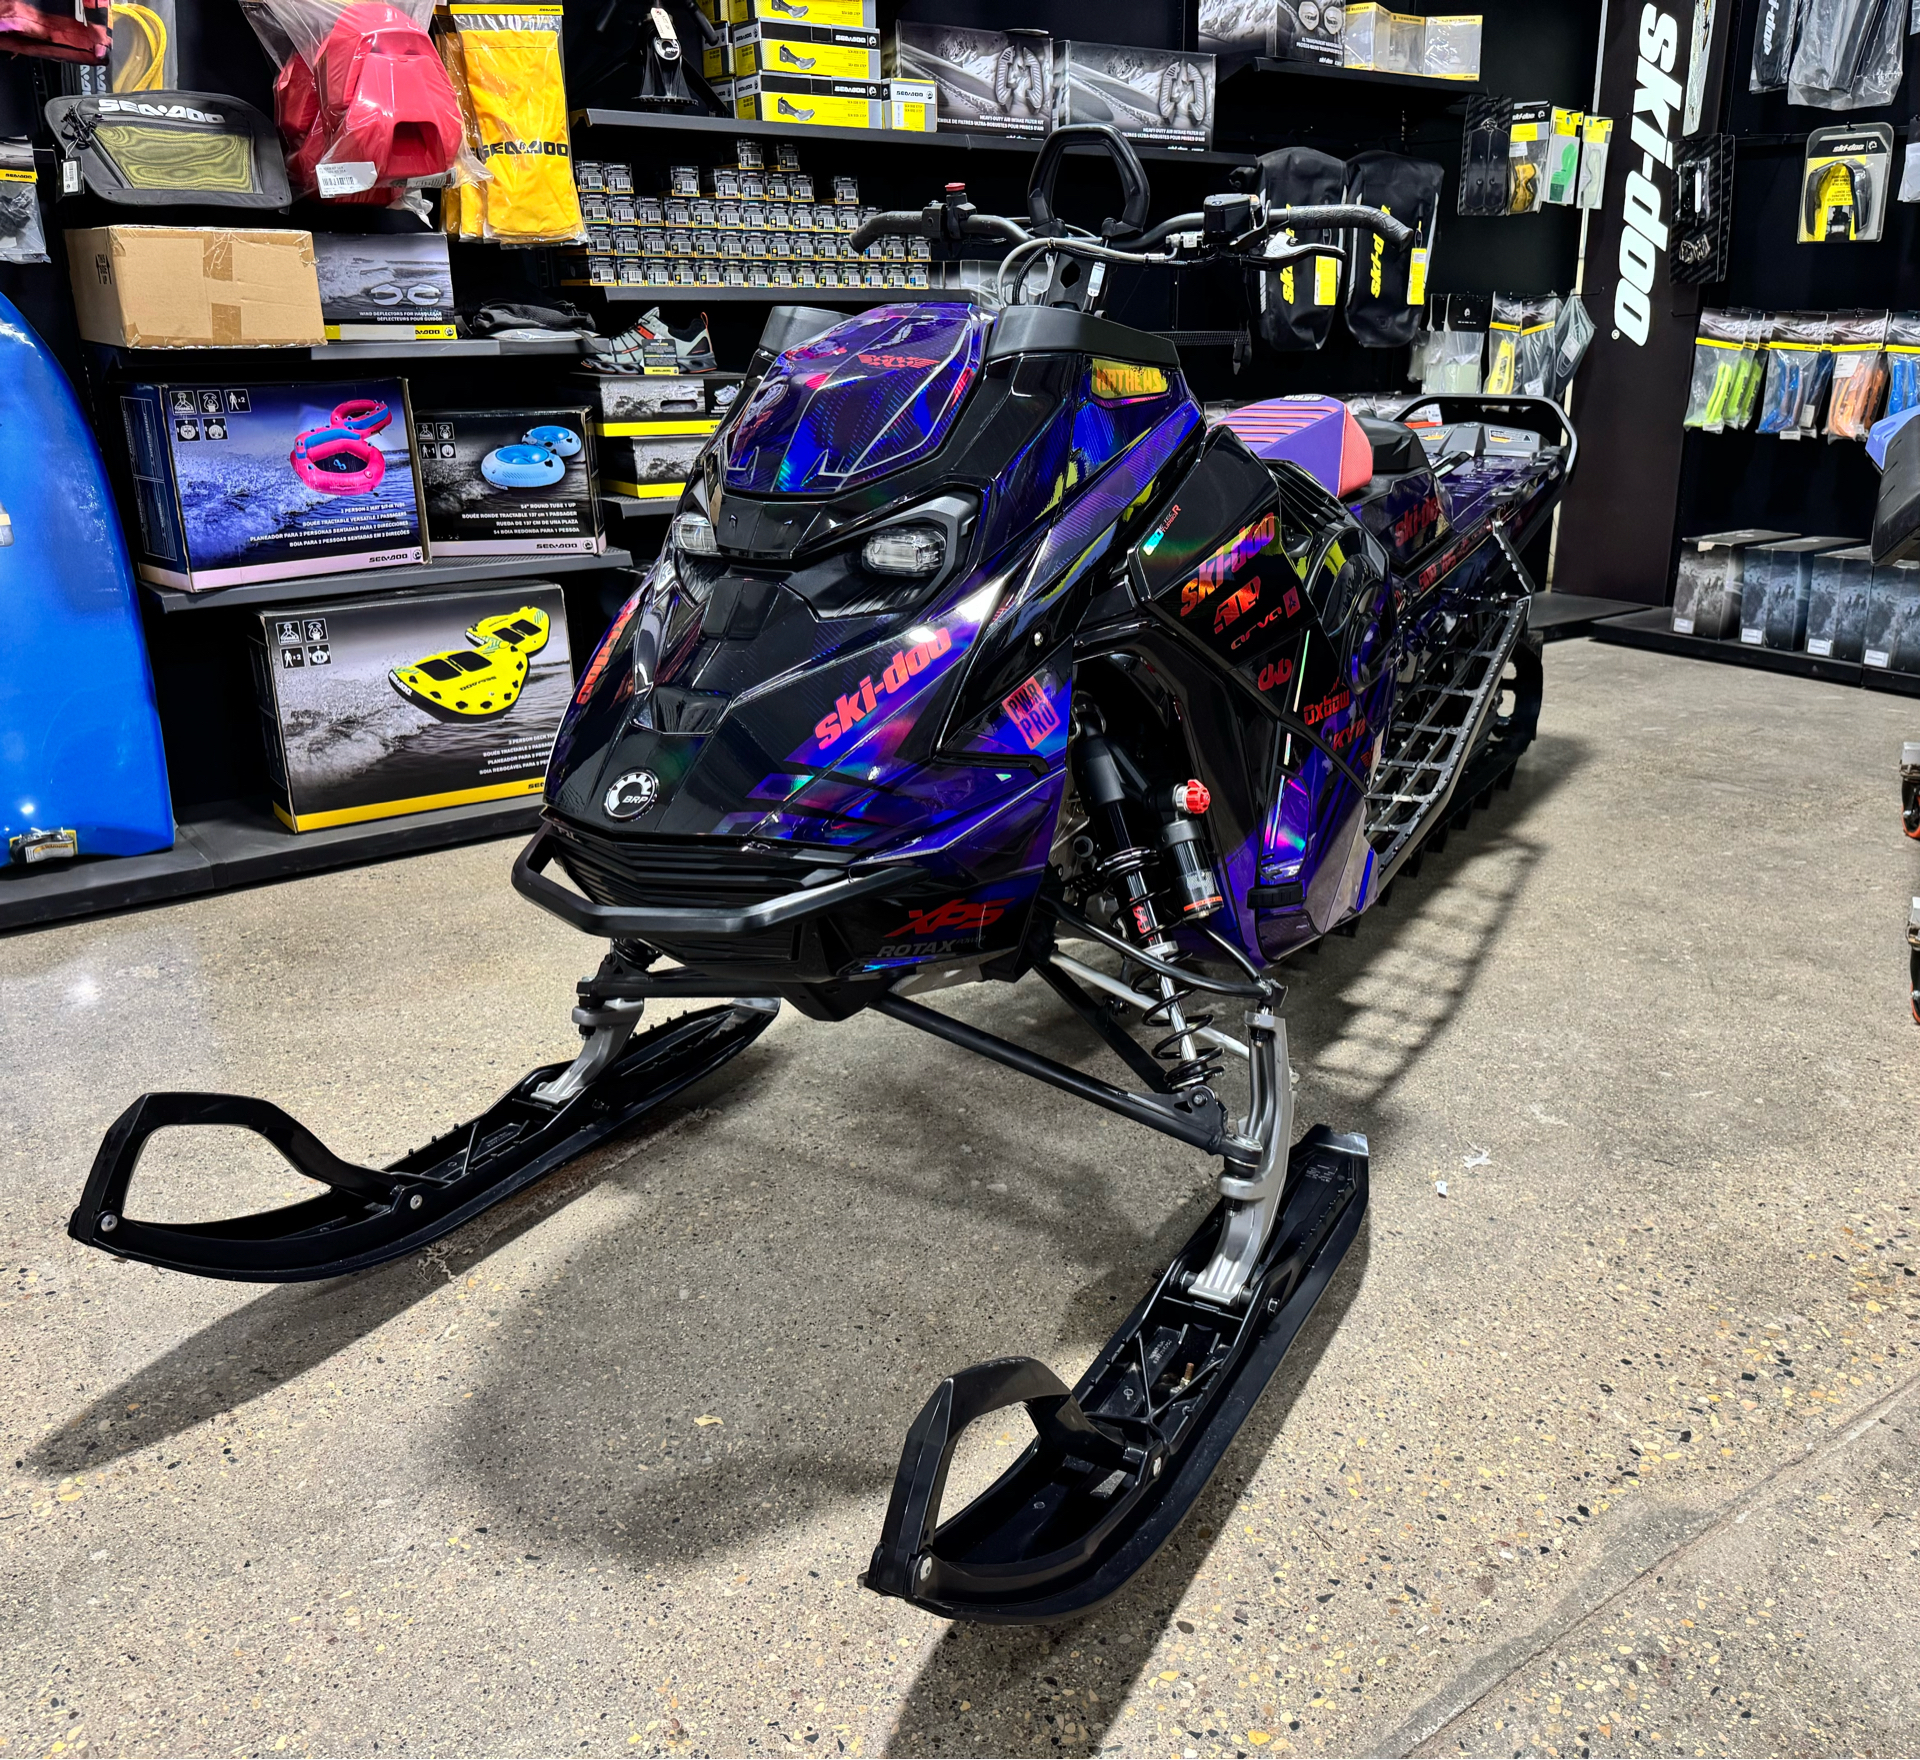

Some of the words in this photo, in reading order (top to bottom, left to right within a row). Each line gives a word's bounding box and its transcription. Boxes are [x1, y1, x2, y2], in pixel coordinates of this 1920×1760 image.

[321, 518, 349, 526] TRACTABLE
[380, 511, 407, 519] PASSAGERS
[250, 533, 283, 542] PLANEADOR
[303, 528, 332, 537] PERSONAS
[323, 536, 347, 544] PESSOAS
[814, 627, 952, 750] ski-doo
[1007, 683, 1042, 720] PWR
[1020, 702, 1056, 743] PRO
[513, 736, 533, 744] PERSON
[501, 746, 528, 755] TRACTABLE
[487, 756, 518, 765] PLANEADOR
[622, 795, 649, 804] BRP
[883, 898, 1016, 938] XPS
[876, 939, 957, 957] ROTAX
